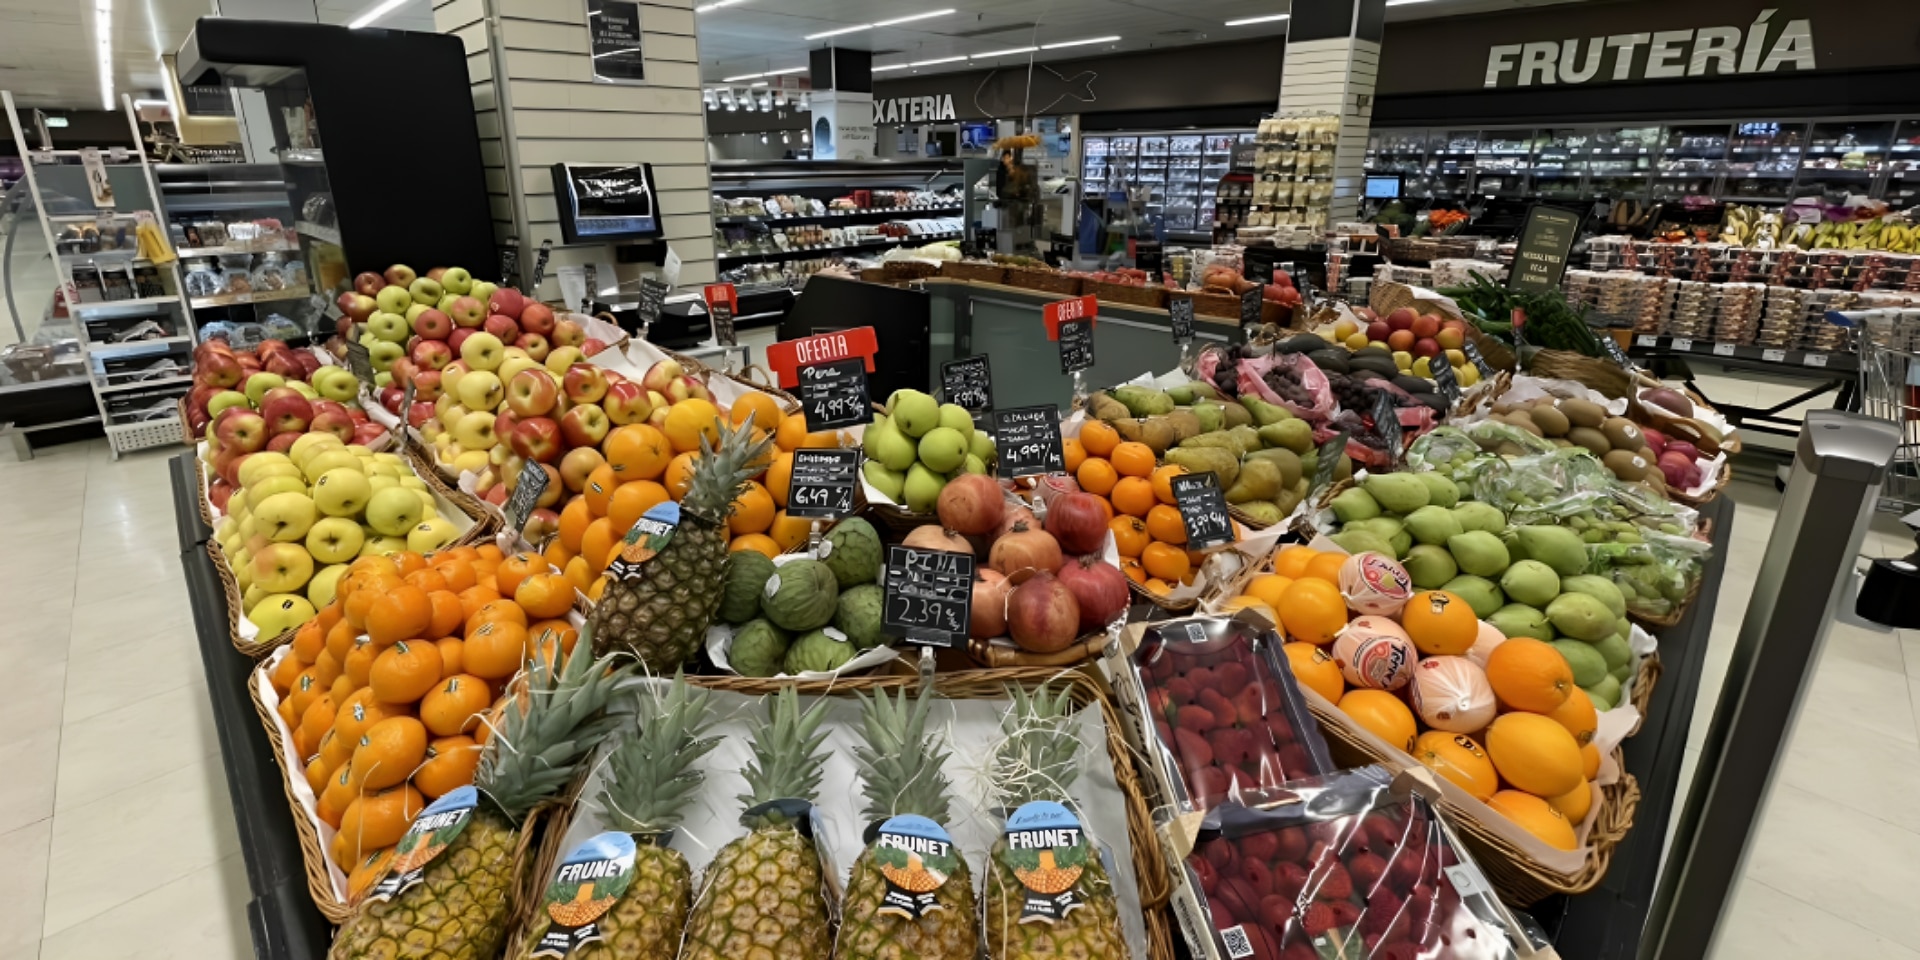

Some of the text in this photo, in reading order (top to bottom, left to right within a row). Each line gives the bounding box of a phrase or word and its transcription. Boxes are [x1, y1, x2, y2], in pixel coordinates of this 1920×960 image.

[1483, 8, 1816, 88] FRUTERÍA
[796, 335, 848, 363] OFERTA
[881, 832, 949, 858] FRUNET
[1009, 828, 1079, 850] FRUNET
[557, 859, 627, 885] FRUNET
